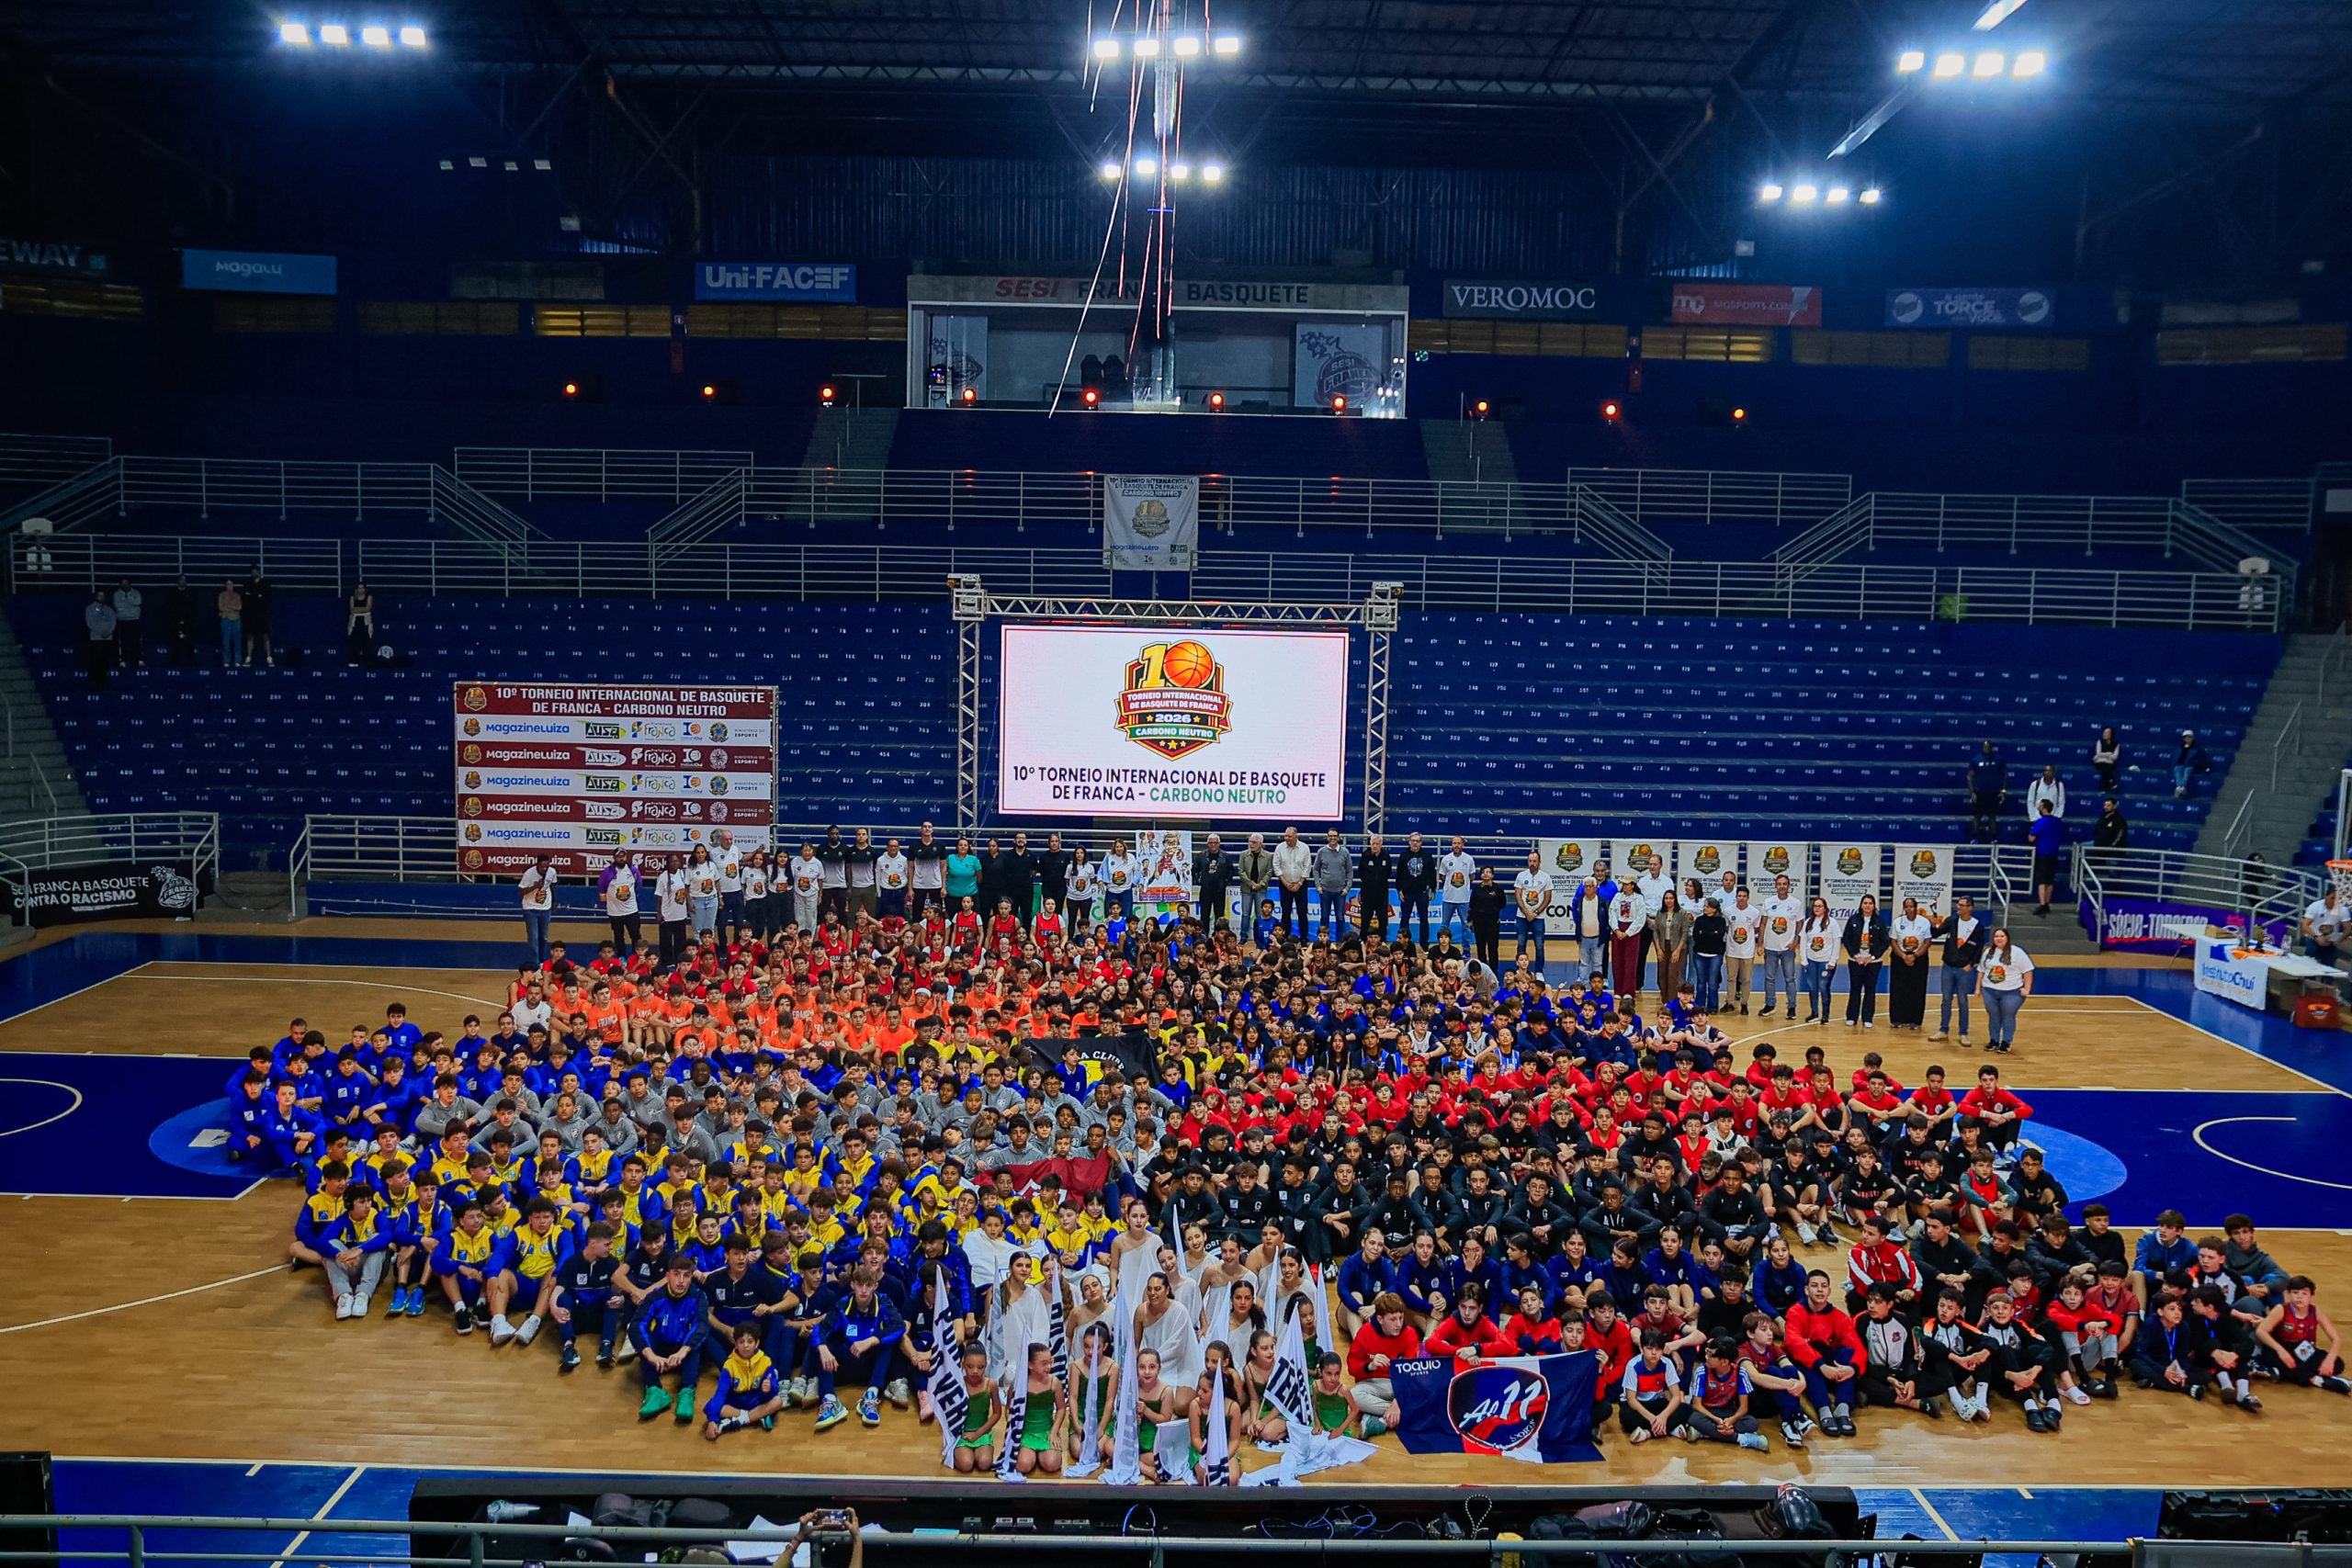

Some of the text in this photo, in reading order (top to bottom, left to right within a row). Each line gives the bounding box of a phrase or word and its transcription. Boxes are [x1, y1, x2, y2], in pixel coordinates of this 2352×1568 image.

[705, 266, 850, 289] Uni-FACEF
[995, 279, 1060, 298] SESI
[1188, 284, 1308, 304] BASQUETE
[1452, 286, 1595, 310] VEROMOC
[1934, 299, 1996, 315] TORCE
[521, 688, 573, 700] TORNEIO
[578, 689, 676, 702] INTERNACIONAL
[680, 691, 697, 702] DE
[699, 692, 765, 704] BASQUETE
[1127, 691, 1223, 705] TORNEIO INTERNACIONAL
[532, 702, 548, 714] DE
[552, 702, 602, 714] FRANCA
[614, 704, 673, 716] CARBONO
[677, 705, 727, 716] NEUTRO
[1130, 702, 1140, 710] DE
[1140, 700, 1179, 709] BASQUETE
[1189, 701, 1219, 712] FRANCA
[1155, 714, 1192, 724] 2026
[1136, 727, 1214, 739] CARBONO NEUTRO
[1038, 767, 1102, 783] TORNEIO
[1106, 769, 1226, 785] INTERNACIONAL
[1229, 772, 1248, 785] DE
[1250, 772, 1326, 788] BASQUETE
[1052, 785, 1070, 799] DE
[1074, 785, 1136, 801] FRANCA
[1149, 787, 1225, 804] CARBONO
[1227, 789, 1286, 805] NEUTRO
[34, 880, 82, 894] FRANCA
[83, 876, 150, 892] BASQUETE
[60, 894, 69, 905] O
[72, 889, 137, 905] RACISMO
[1396, 1359, 1442, 1374] TOQUIO
